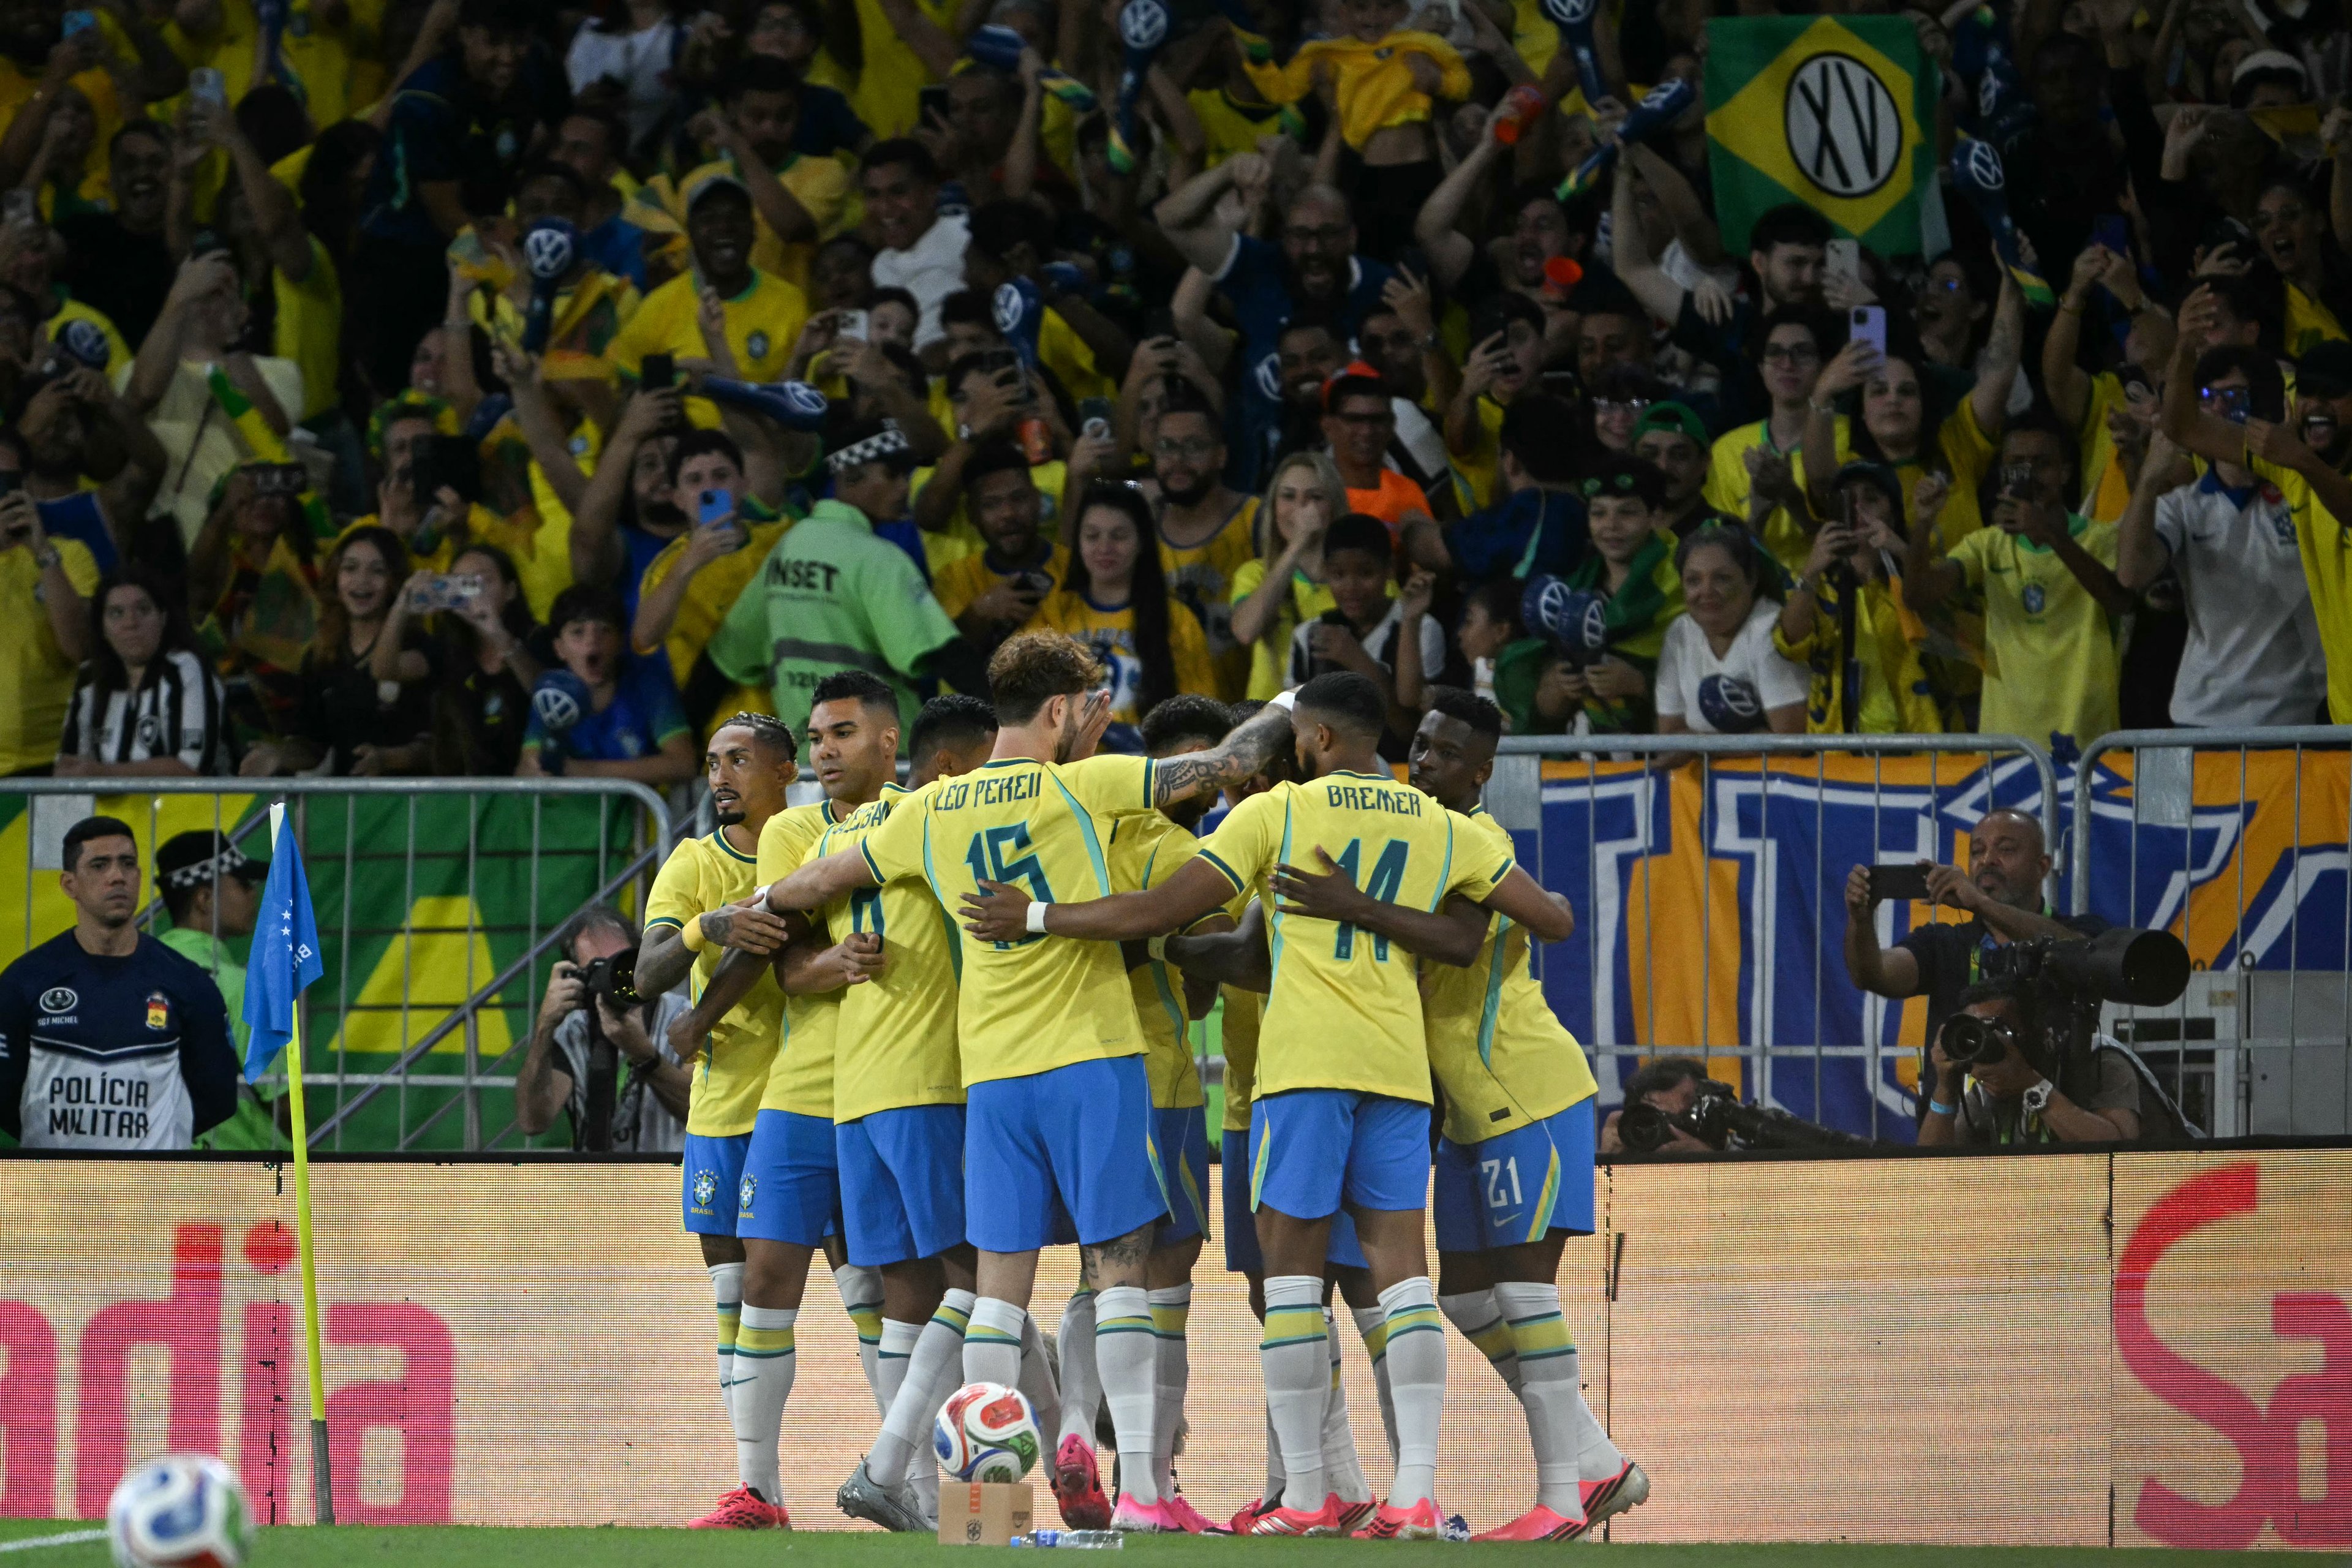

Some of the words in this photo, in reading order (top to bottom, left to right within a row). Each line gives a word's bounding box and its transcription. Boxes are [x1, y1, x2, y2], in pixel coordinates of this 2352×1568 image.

[1798, 60, 1879, 188] XV
[1326, 785, 1422, 818] BREMER
[49, 1072, 149, 1108] POLÍCIA
[49, 1109, 149, 1139] MILITAR
[1481, 1156, 1523, 1208] 21
[690, 1207, 715, 1216] BRASIL
